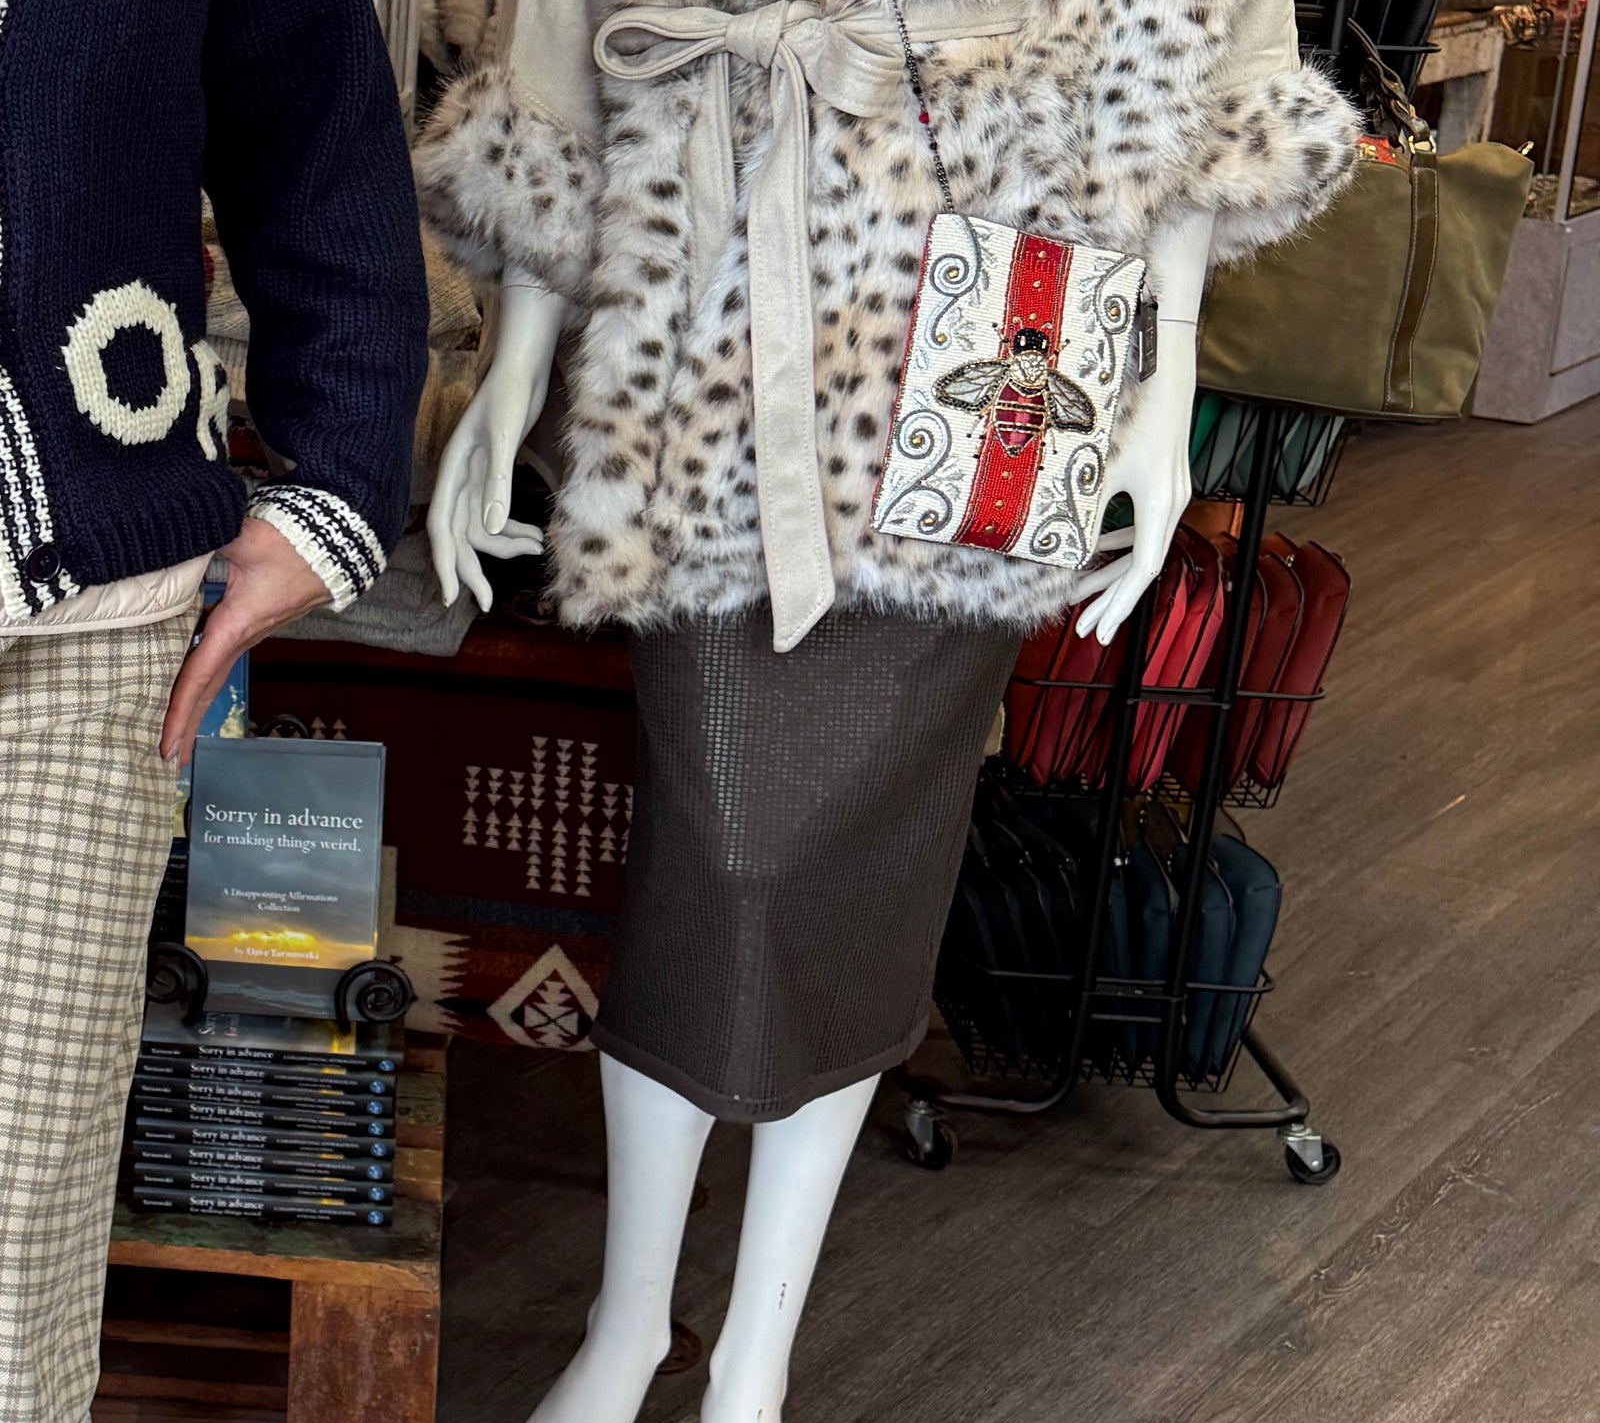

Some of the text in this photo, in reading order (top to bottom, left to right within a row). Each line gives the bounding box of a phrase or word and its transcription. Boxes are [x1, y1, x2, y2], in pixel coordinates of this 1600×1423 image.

[205, 804, 363, 830] Sorry in advance
[204, 830, 361, 853] for making things weird.
[231, 888, 286, 902] Disappointing
[289, 891, 338, 902] Affirmations
[258, 903, 300, 912] Collection
[199, 1046, 274, 1058] Sorry in advance
[191, 1062, 265, 1077] Sorry in advance
[188, 1082, 262, 1097] Sorry in advance
[190, 1103, 264, 1118] Sorry in advance
[192, 1129, 267, 1142] Sorry in advance
[189, 1148, 264, 1163] Sorry in advance
[190, 1173, 265, 1186] Sorry in advance
[190, 1196, 264, 1210] Sorry in advance
